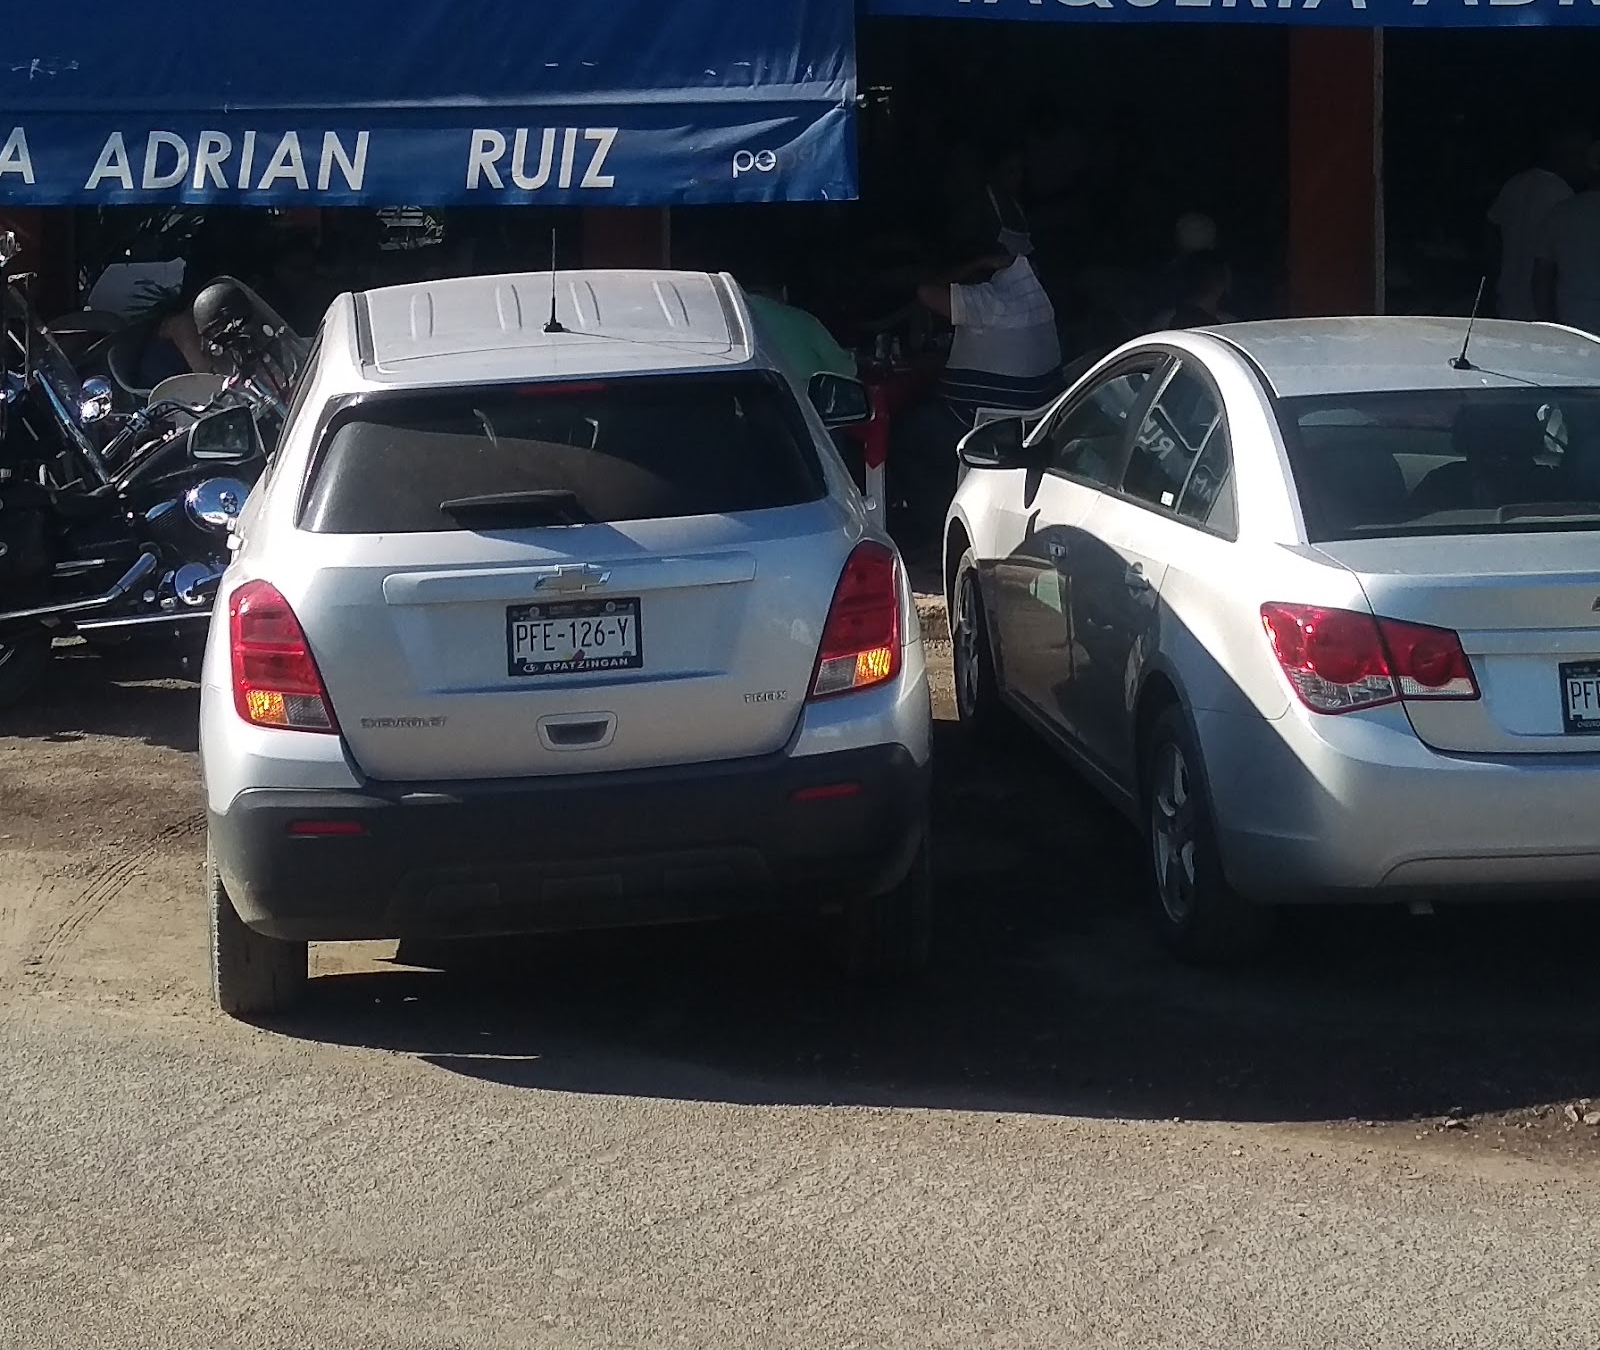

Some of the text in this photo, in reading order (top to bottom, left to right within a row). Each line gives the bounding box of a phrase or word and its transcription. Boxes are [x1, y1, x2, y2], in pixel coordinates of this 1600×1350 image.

[84, 130, 370, 191] ADRIAN
[466, 127, 619, 191] RUIZ
[516, 617, 629, 653] PFE-126-Y
[543, 657, 629, 671] APATZINGAN
